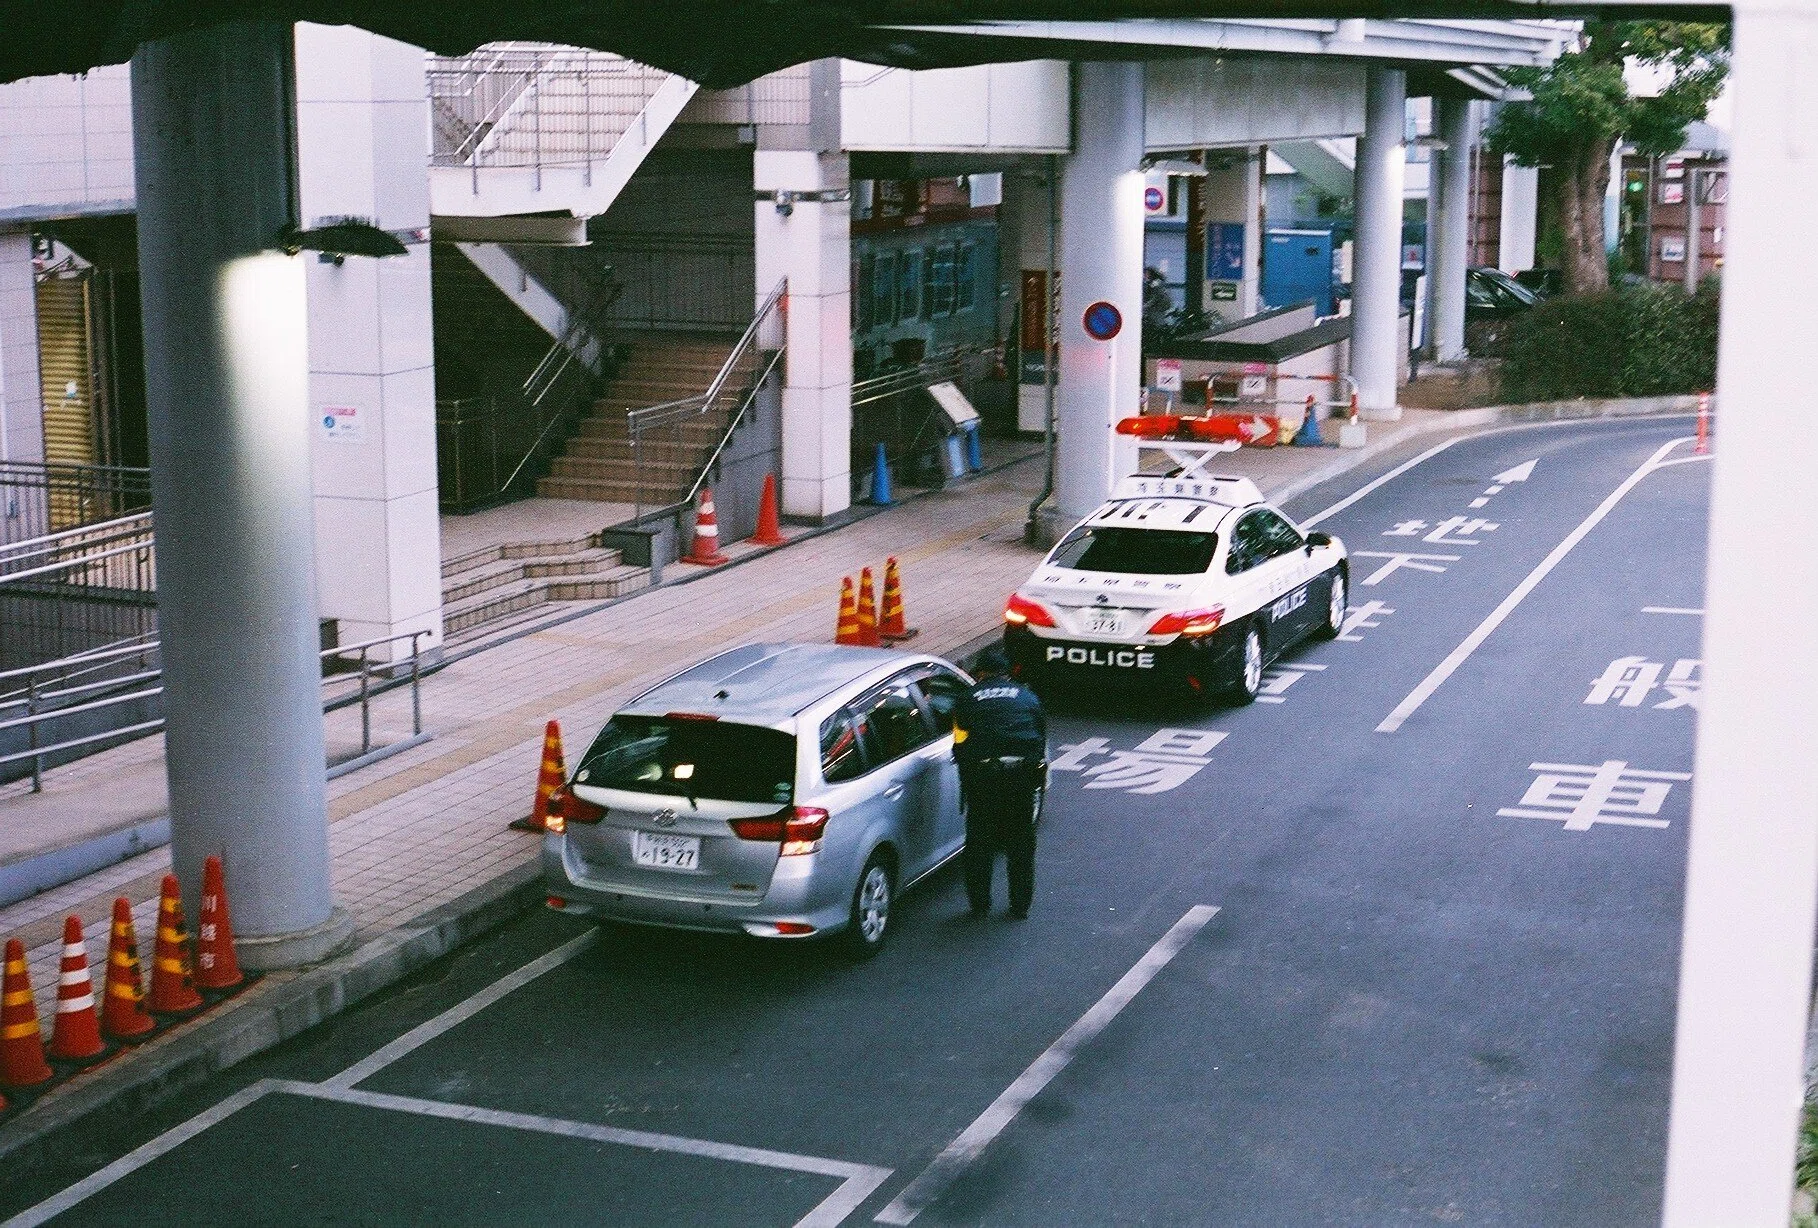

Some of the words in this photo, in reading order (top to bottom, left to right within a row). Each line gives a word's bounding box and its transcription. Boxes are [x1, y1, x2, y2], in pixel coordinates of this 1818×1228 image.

[1271, 587, 1308, 623] POLICE
[1046, 646, 1155, 669] POLICE
[652, 845, 694, 868] 19-27
